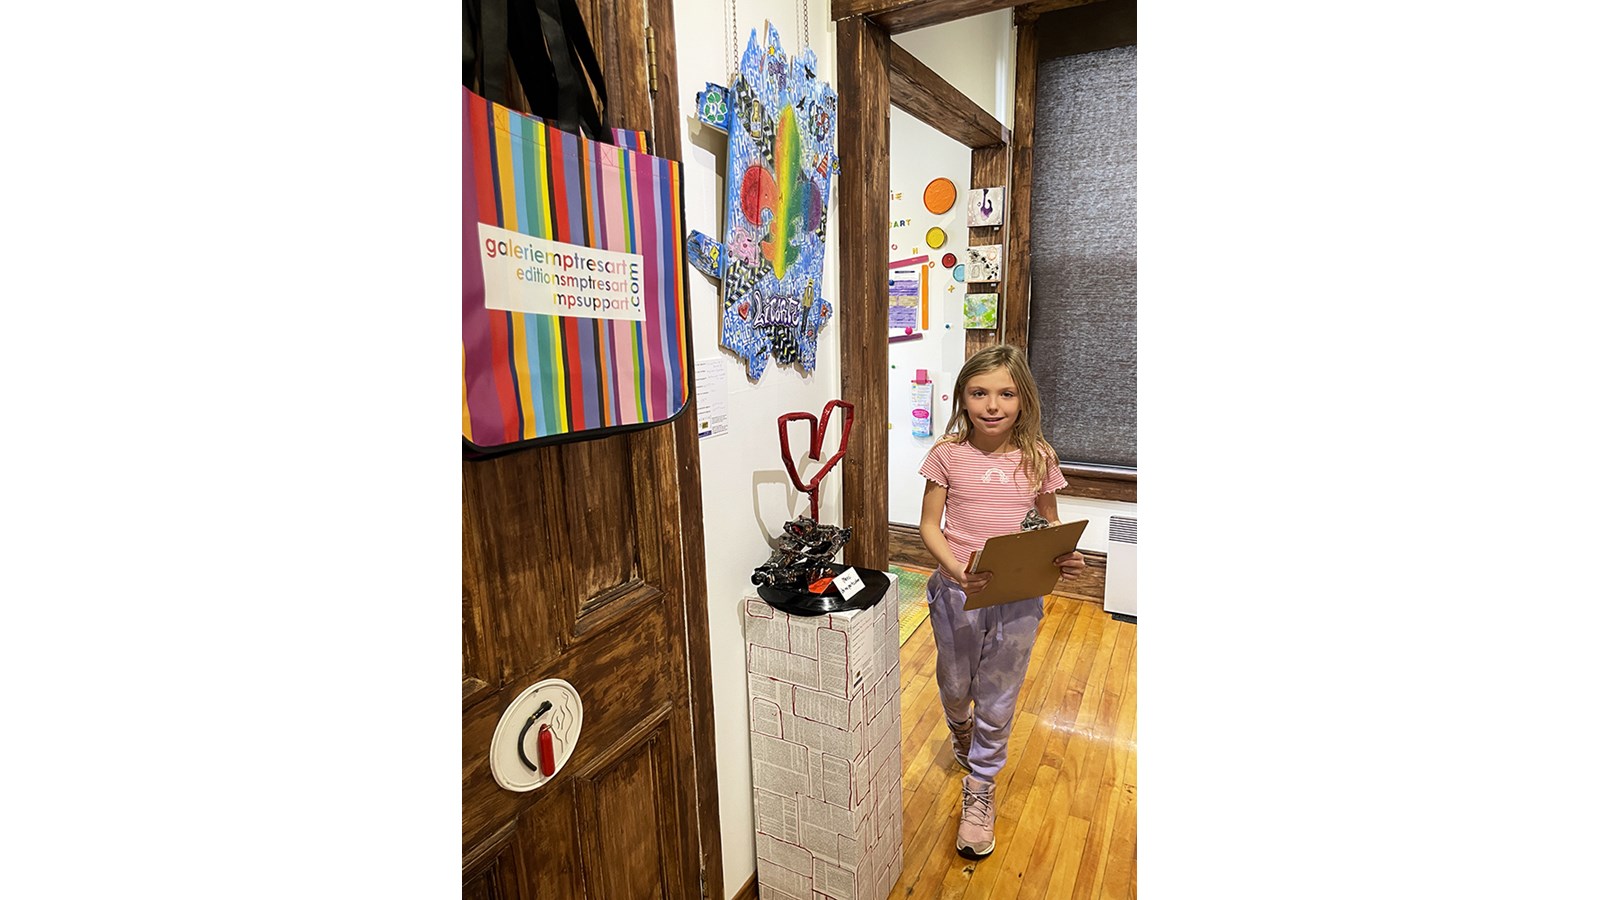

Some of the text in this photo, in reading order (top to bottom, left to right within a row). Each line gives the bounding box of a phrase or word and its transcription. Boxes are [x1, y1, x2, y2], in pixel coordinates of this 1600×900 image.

[485, 238, 627, 275] galeriemptresart
[516, 267, 628, 292] editionsmptresart
[553, 292, 629, 312] mpsuppart
